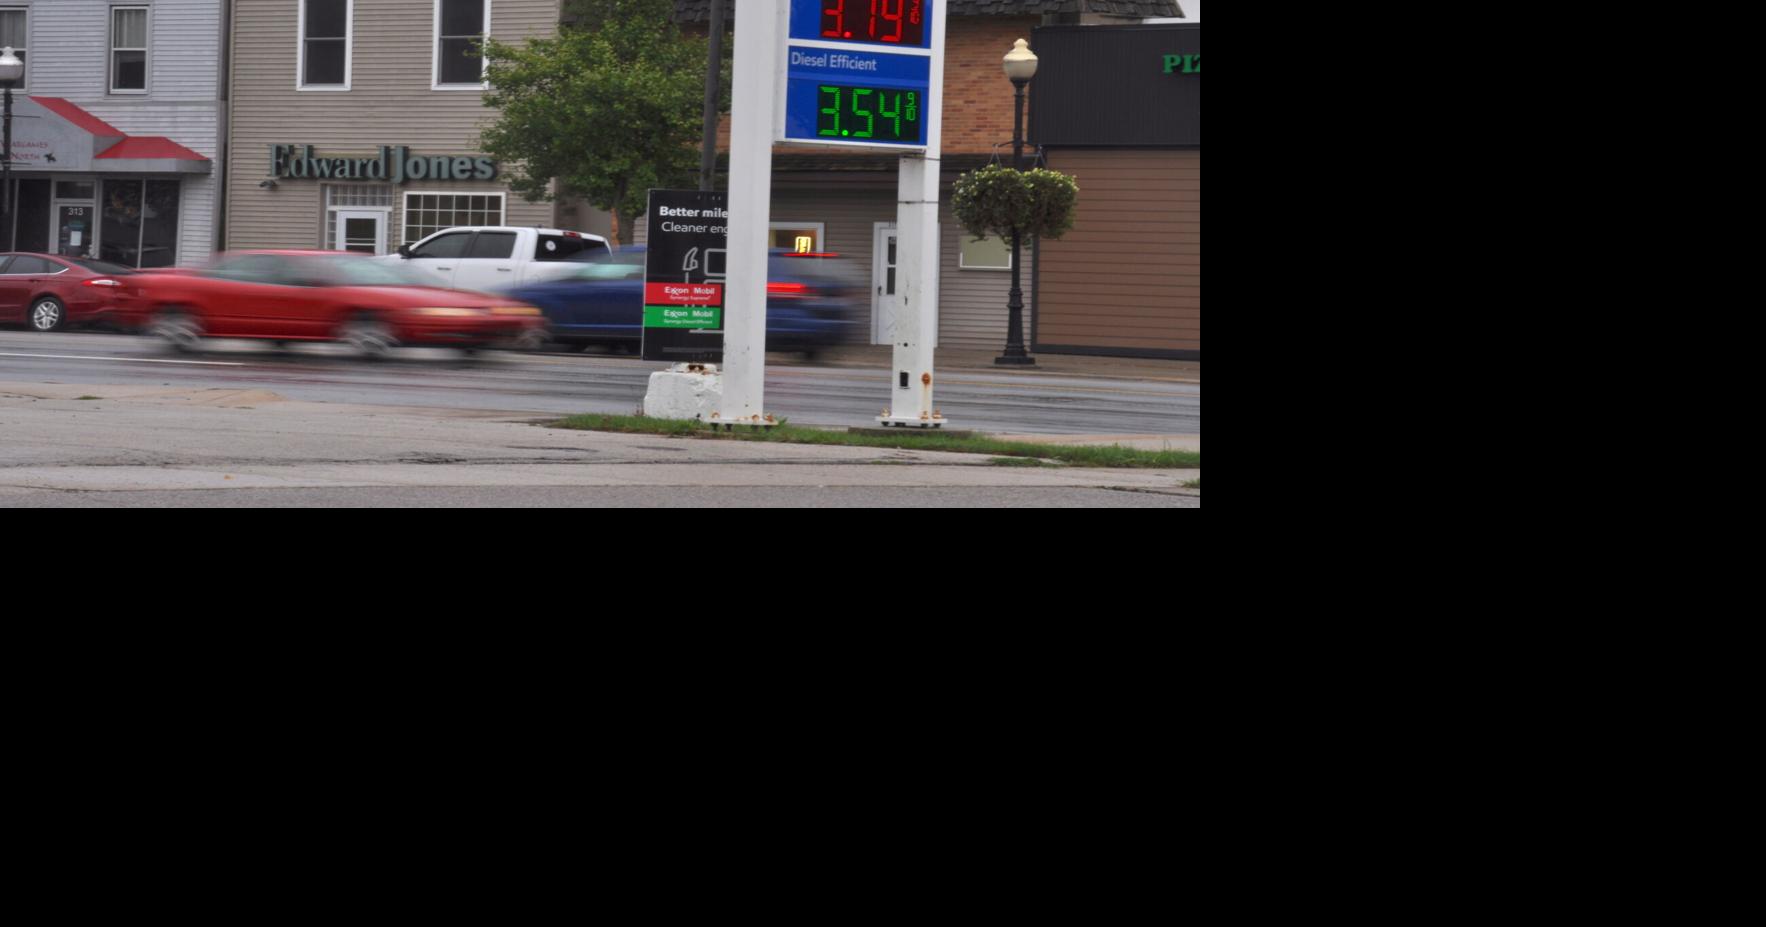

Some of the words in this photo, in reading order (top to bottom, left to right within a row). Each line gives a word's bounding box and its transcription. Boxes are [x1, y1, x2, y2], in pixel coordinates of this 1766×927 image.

[791, 51, 827, 67] Diesel
[829, 54, 877, 71] Efficient
[819, 86, 900, 137] 3.54
[270, 144, 389, 178] Edward
[391, 144, 495, 183] Jones
[68, 207, 84, 216] 313
[659, 206, 700, 217] Better
[661, 221, 708, 233] Cleaner
[664, 286, 689, 295] Exxon
[693, 287, 715, 295] Mobil
[663, 309, 688, 318] Exxon
